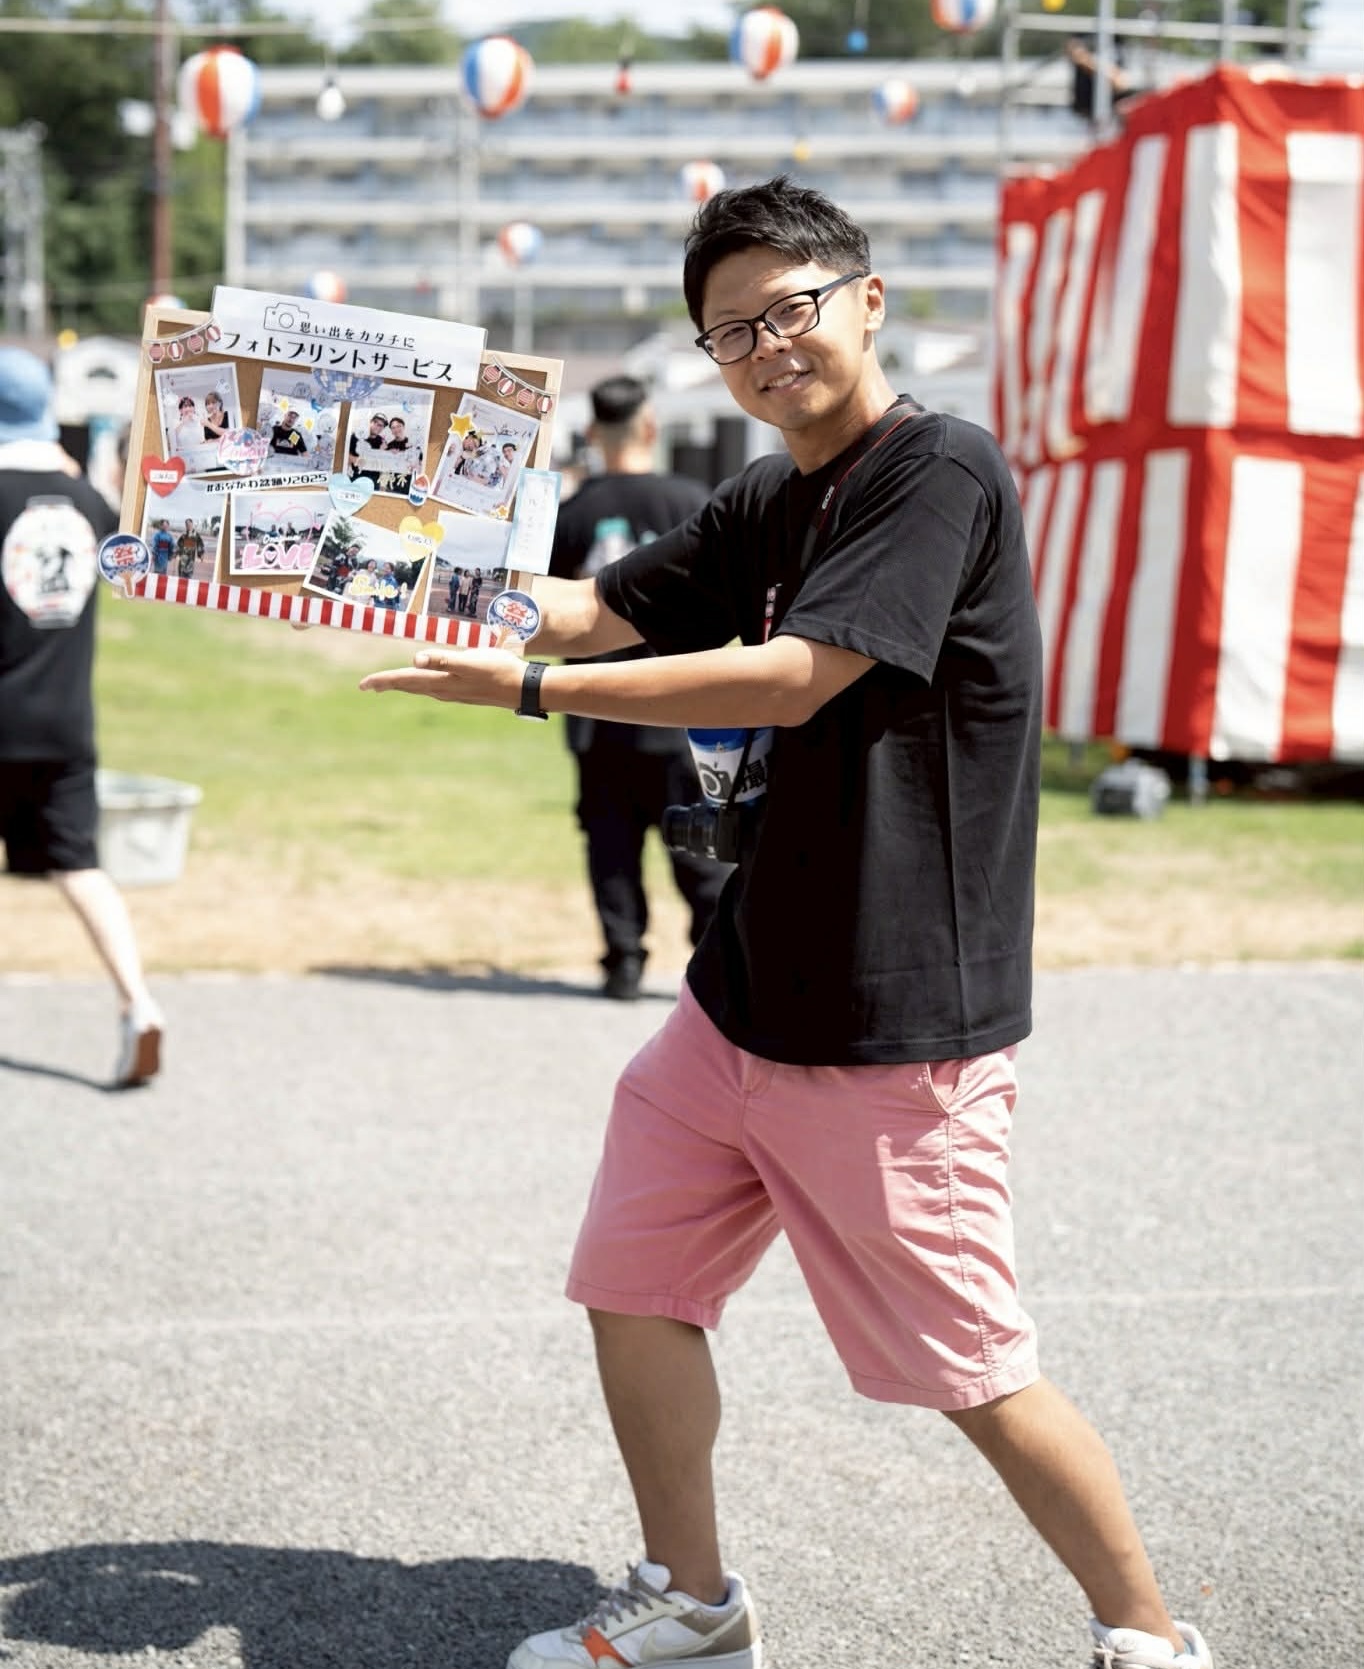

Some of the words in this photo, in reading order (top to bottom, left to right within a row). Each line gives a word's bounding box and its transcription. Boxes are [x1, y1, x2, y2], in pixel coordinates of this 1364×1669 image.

[299, 321, 416, 349] 思い出をカタチに
[223, 331, 453, 382] フォトプリントサービス
[821, 484, 835, 511] EOS
[241, 542, 316, 570] LOVE
